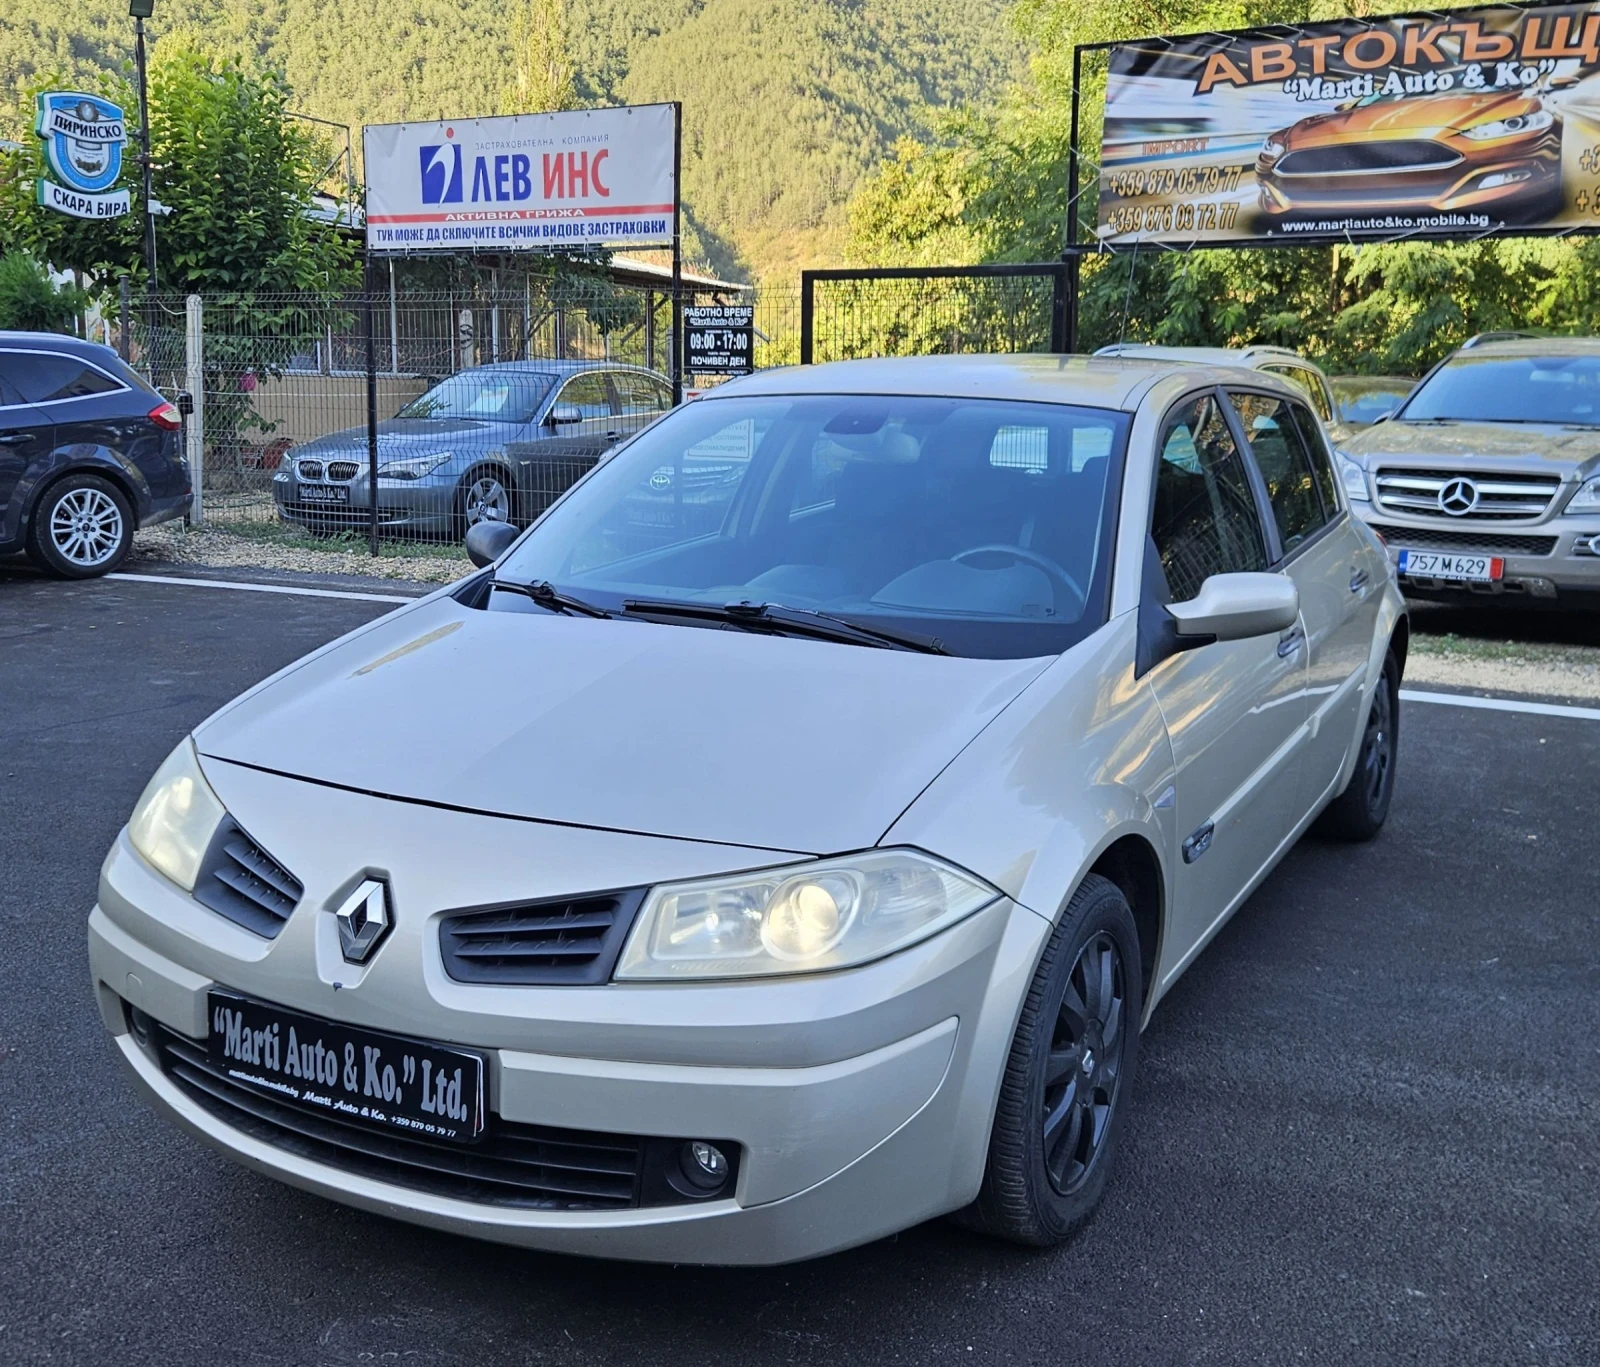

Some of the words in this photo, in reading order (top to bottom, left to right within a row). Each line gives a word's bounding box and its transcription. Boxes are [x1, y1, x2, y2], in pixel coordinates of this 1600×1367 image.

[1283, 73, 1375, 101] “Marti
[1380, 69, 1454, 95] Auto
[1462, 62, 1487, 86] &
[1494, 58, 1557, 86] Ko”
[54, 114, 122, 139] ПИРИНСКО
[475, 138, 554, 150] ЗАСТРАХОВАТЕЛНА
[562, 133, 610, 145] КОМПАНИЯ
[1142, 138, 1209, 156] IMPORT
[471, 154, 532, 203] ЛЕВ
[542, 149, 610, 200] ИНС
[1110, 170, 1145, 196] +359
[1147, 168, 1175, 195] 879
[1177, 167, 1198, 194] 05
[1200, 166, 1220, 193] 79
[1222, 165, 1243, 192] 77
[53, 188, 93, 215] СКАРА
[97, 201, 128, 216] БИРА
[445, 210, 521, 221] АКТИВНА
[525, 208, 585, 219] ГРИЖА
[1107, 205, 1143, 233] +359
[1145, 204, 1173, 231] 876
[1176, 203, 1194, 231] 03
[1197, 202, 1217, 230] 72
[1219, 202, 1240, 229] 77
[1281, 213, 1489, 232] www.martiauto&ko.mobile.bg
[377, 229, 394, 242] ТУК
[395, 228, 424, 242] МОЖЕ
[426, 228, 440, 243] ДА
[442, 226, 496, 240] СКЛЮЧИТЕ
[499, 225, 540, 239] ВСИЧКИ
[542, 223, 586, 237] ВИДОВЕ
[588, 220, 666, 236] ЗАСТРАХОВКИ
[684, 308, 722, 317] РАБОТНО
[724, 308, 752, 317] ВРЕМЕ
[690, 332, 715, 349] 09:00
[722, 333, 748, 350] 17:00
[691, 356, 728, 365] ПОЧИВЕН
[729, 356, 746, 366] ДЕН
[1410, 554, 1438, 571] 757
[1441, 557, 1452, 572] M
[1455, 558, 1486, 574] 629
[214, 1005, 280, 1071] “Marti
[284, 1025, 338, 1086] Auto
[343, 1042, 358, 1094] &
[364, 1045, 416, 1105] Ko.”
[421, 1059, 468, 1123] Ltd.
[302, 1091, 332, 1106] Marti
[333, 1099, 359, 1114] Auto
[361, 1107, 369, 1117] &
[370, 1109, 387, 1121] Ko.
[390, 1115, 410, 1127] +359
[410, 1119, 424, 1130] 879
[425, 1123, 435, 1133] 05
[436, 1126, 446, 1136] 79
[447, 1129, 457, 1138] 77
